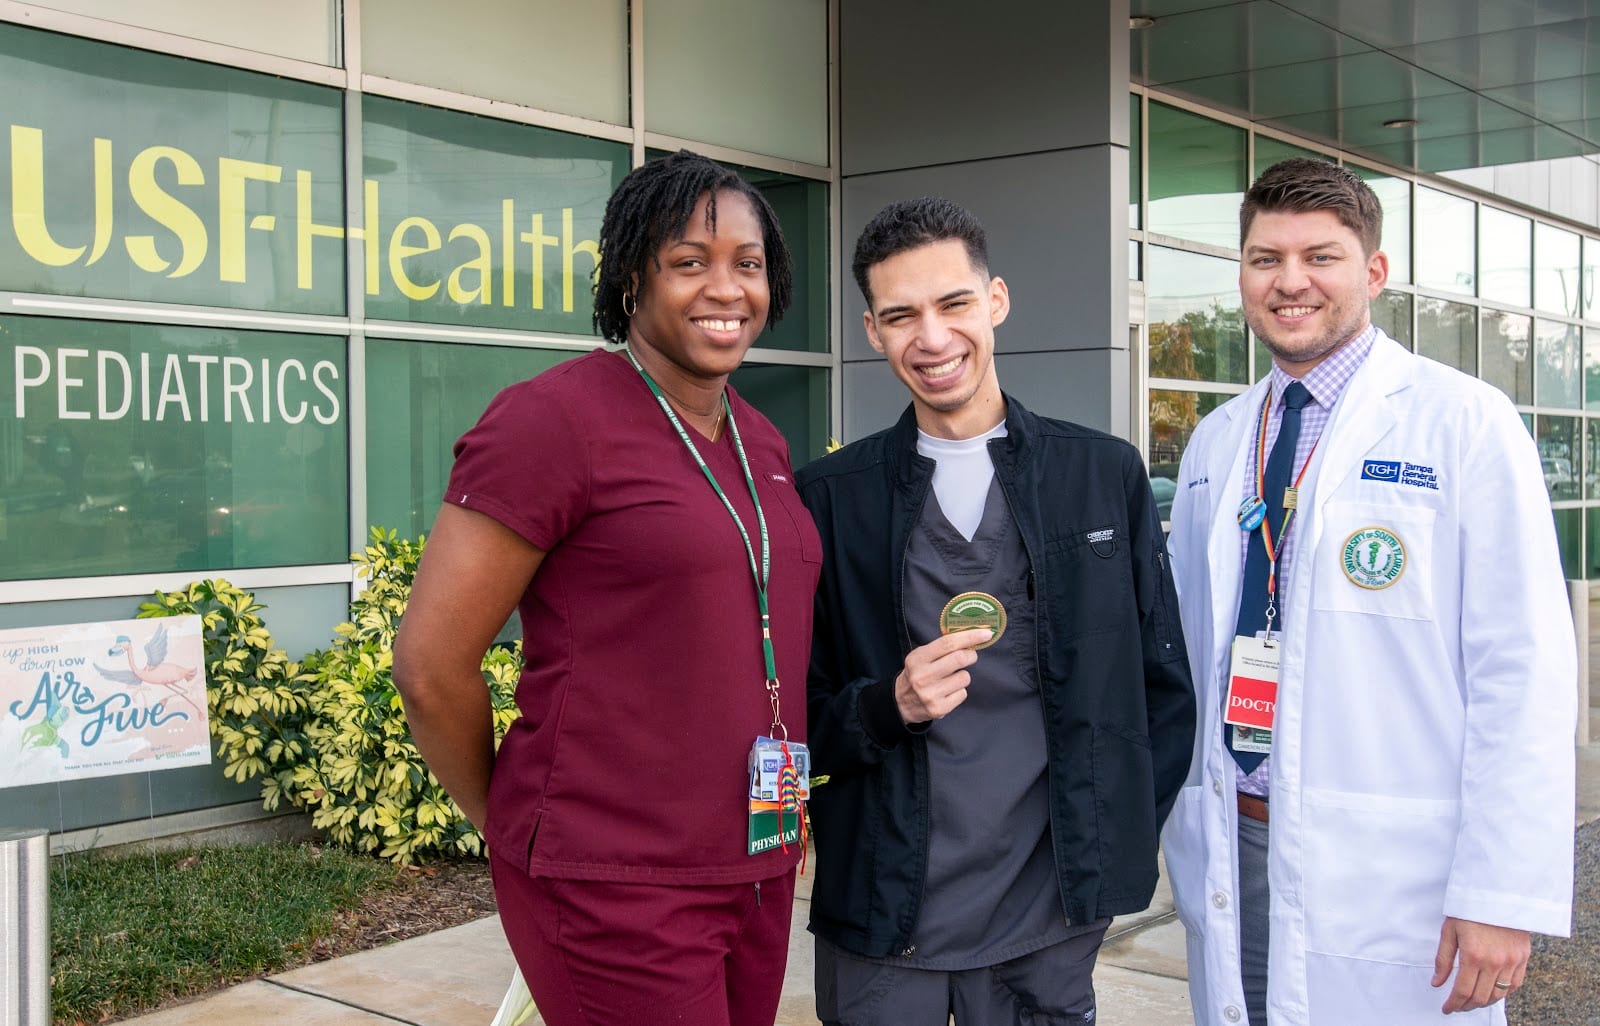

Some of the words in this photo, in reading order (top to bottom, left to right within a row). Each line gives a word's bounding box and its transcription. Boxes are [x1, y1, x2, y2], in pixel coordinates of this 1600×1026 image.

[15, 346, 340, 425] PEDIATRICS
[1369, 464, 1398, 475] TGH
[1403, 470, 1437, 481] General
[1404, 462, 1433, 473] Tampa
[1374, 531, 1398, 547] SOUTH
[1345, 531, 1365, 574] UNIVERSITY
[1384, 548, 1403, 580] FLORIDA
[3, 647, 24, 663] up
[28, 645, 59, 654] HIGH
[59, 657, 86, 667] LOW
[10, 671, 95, 721] Air
[75, 693, 188, 747] Five
[751, 829, 797, 852] PHYSICIAN
